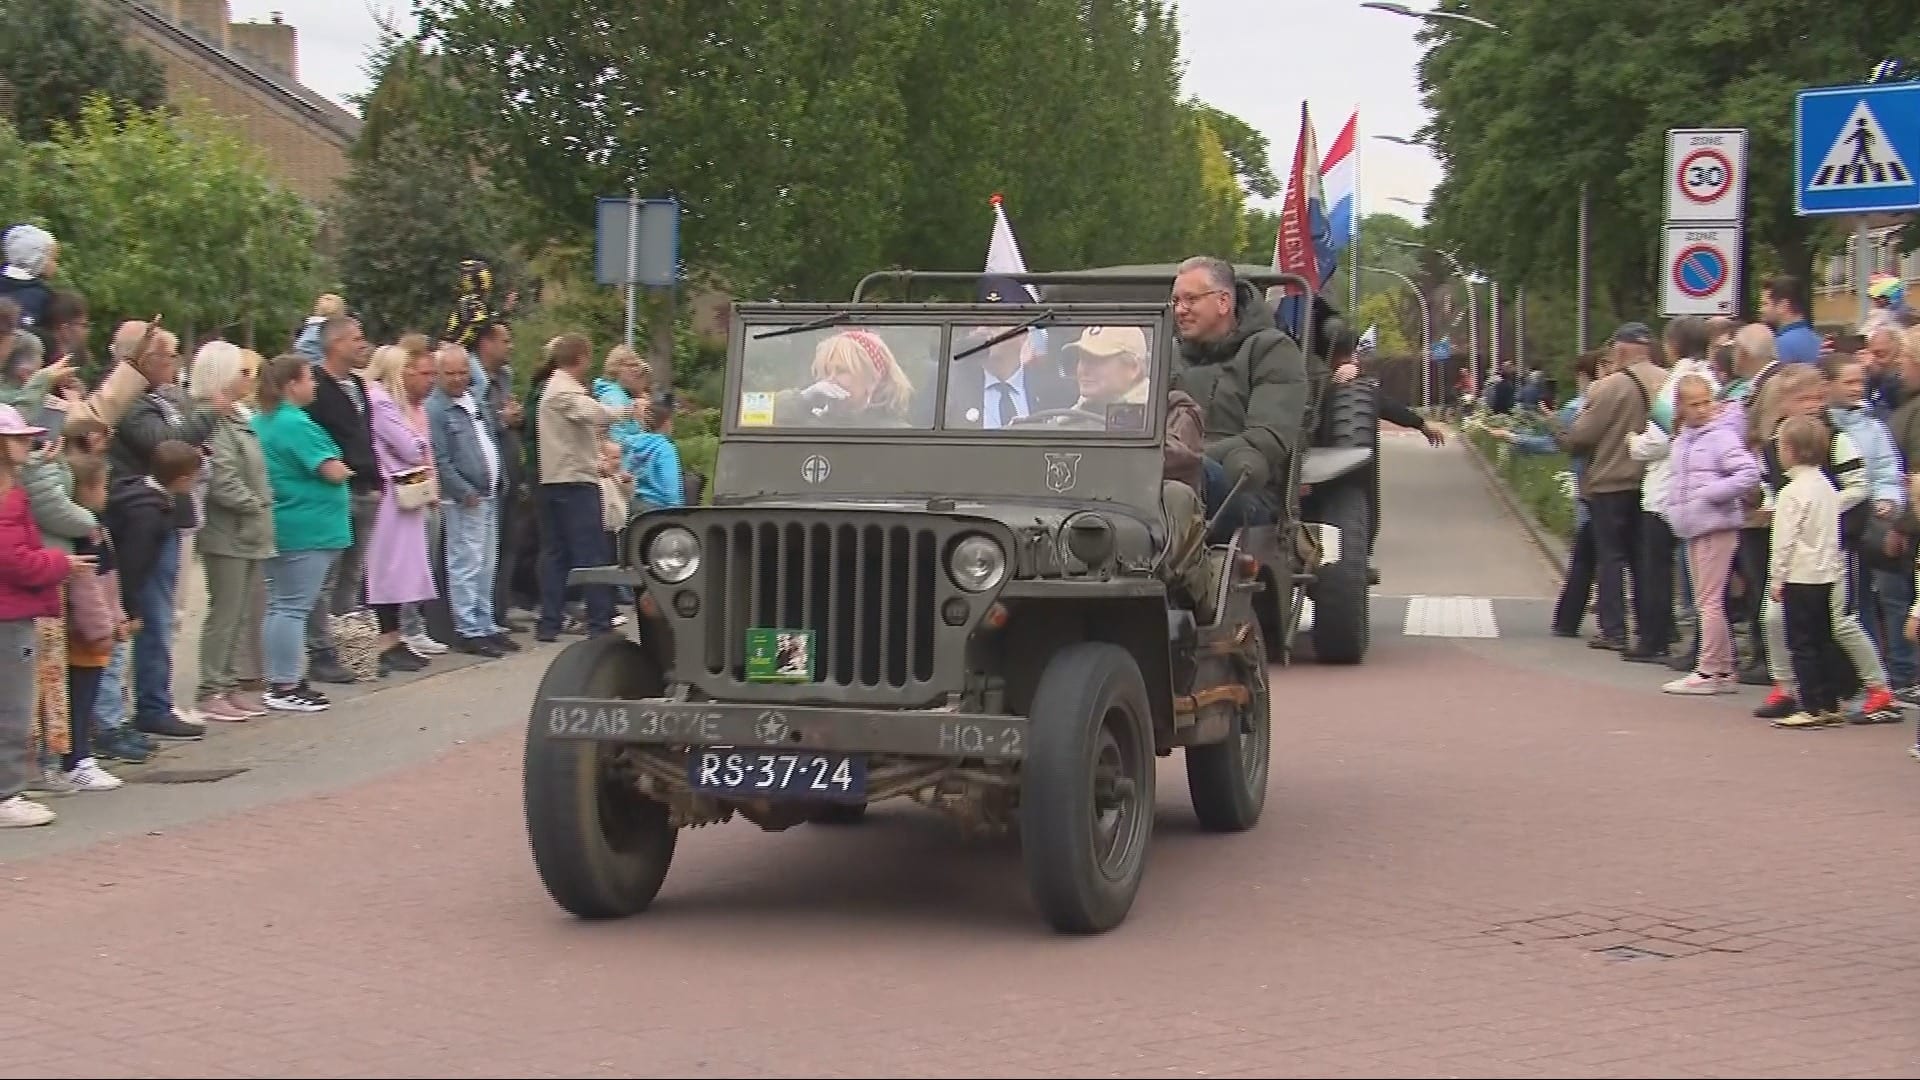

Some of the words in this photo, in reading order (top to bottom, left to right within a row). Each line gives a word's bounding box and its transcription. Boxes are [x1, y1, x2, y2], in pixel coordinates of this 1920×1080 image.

[1689, 136, 1725, 147] ZONE
[1688, 166, 1725, 187] 30
[1684, 231, 1720, 242] ZONE
[547, 706, 631, 735] 82AB
[938, 723, 1023, 754] HQ-2
[698, 752, 854, 792] RS-37-24
